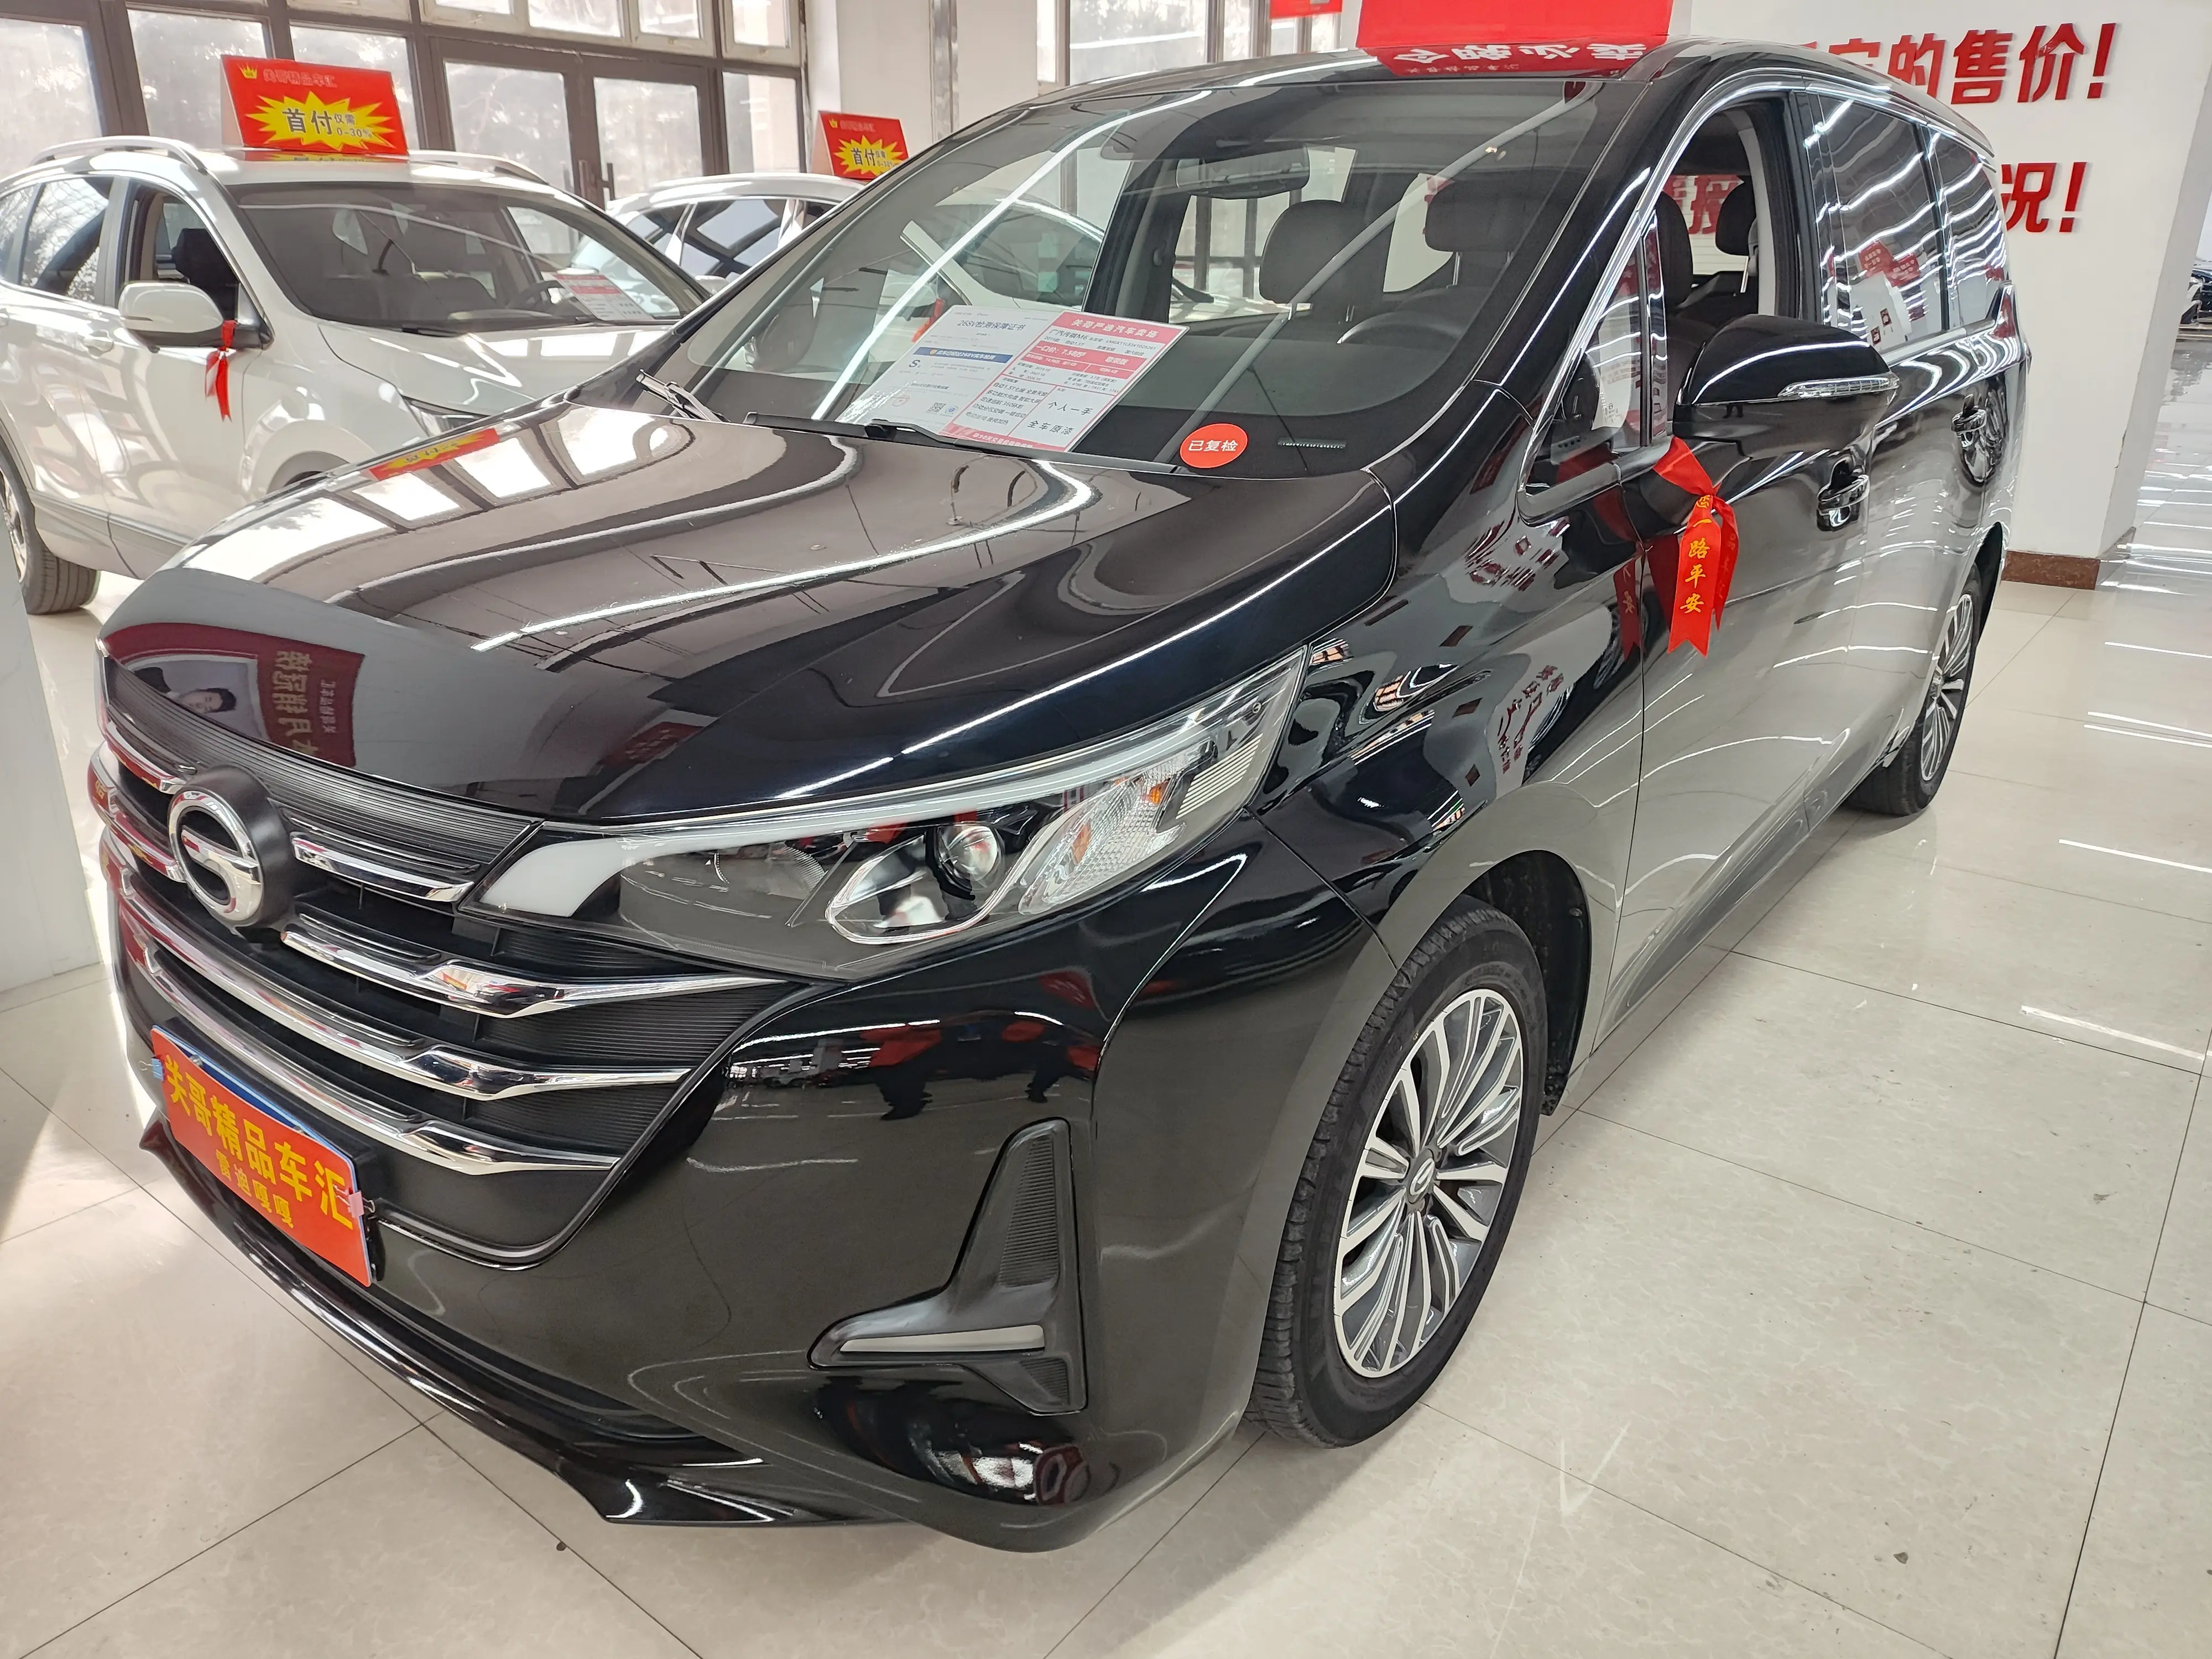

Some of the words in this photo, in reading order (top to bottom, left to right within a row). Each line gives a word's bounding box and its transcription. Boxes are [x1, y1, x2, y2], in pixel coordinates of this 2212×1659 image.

[1798, 23, 2117, 106] 的售价！
[281, 107, 332, 135] 首付
[334, 113, 356, 126] 仅需
[336, 128, 373, 138] 0-30%
[851, 147, 875, 166] 首付
[1049, 329, 1088, 340] 广汽传祺M6
[1046, 401, 1093, 416] 个人一手
[1027, 420, 1074, 435] 全车原漆
[1187, 440, 1239, 452] 已复检
[164, 1054, 354, 1230] 关哥精品车汇
[215, 1149, 295, 1229] 雷迪嘎嘎
